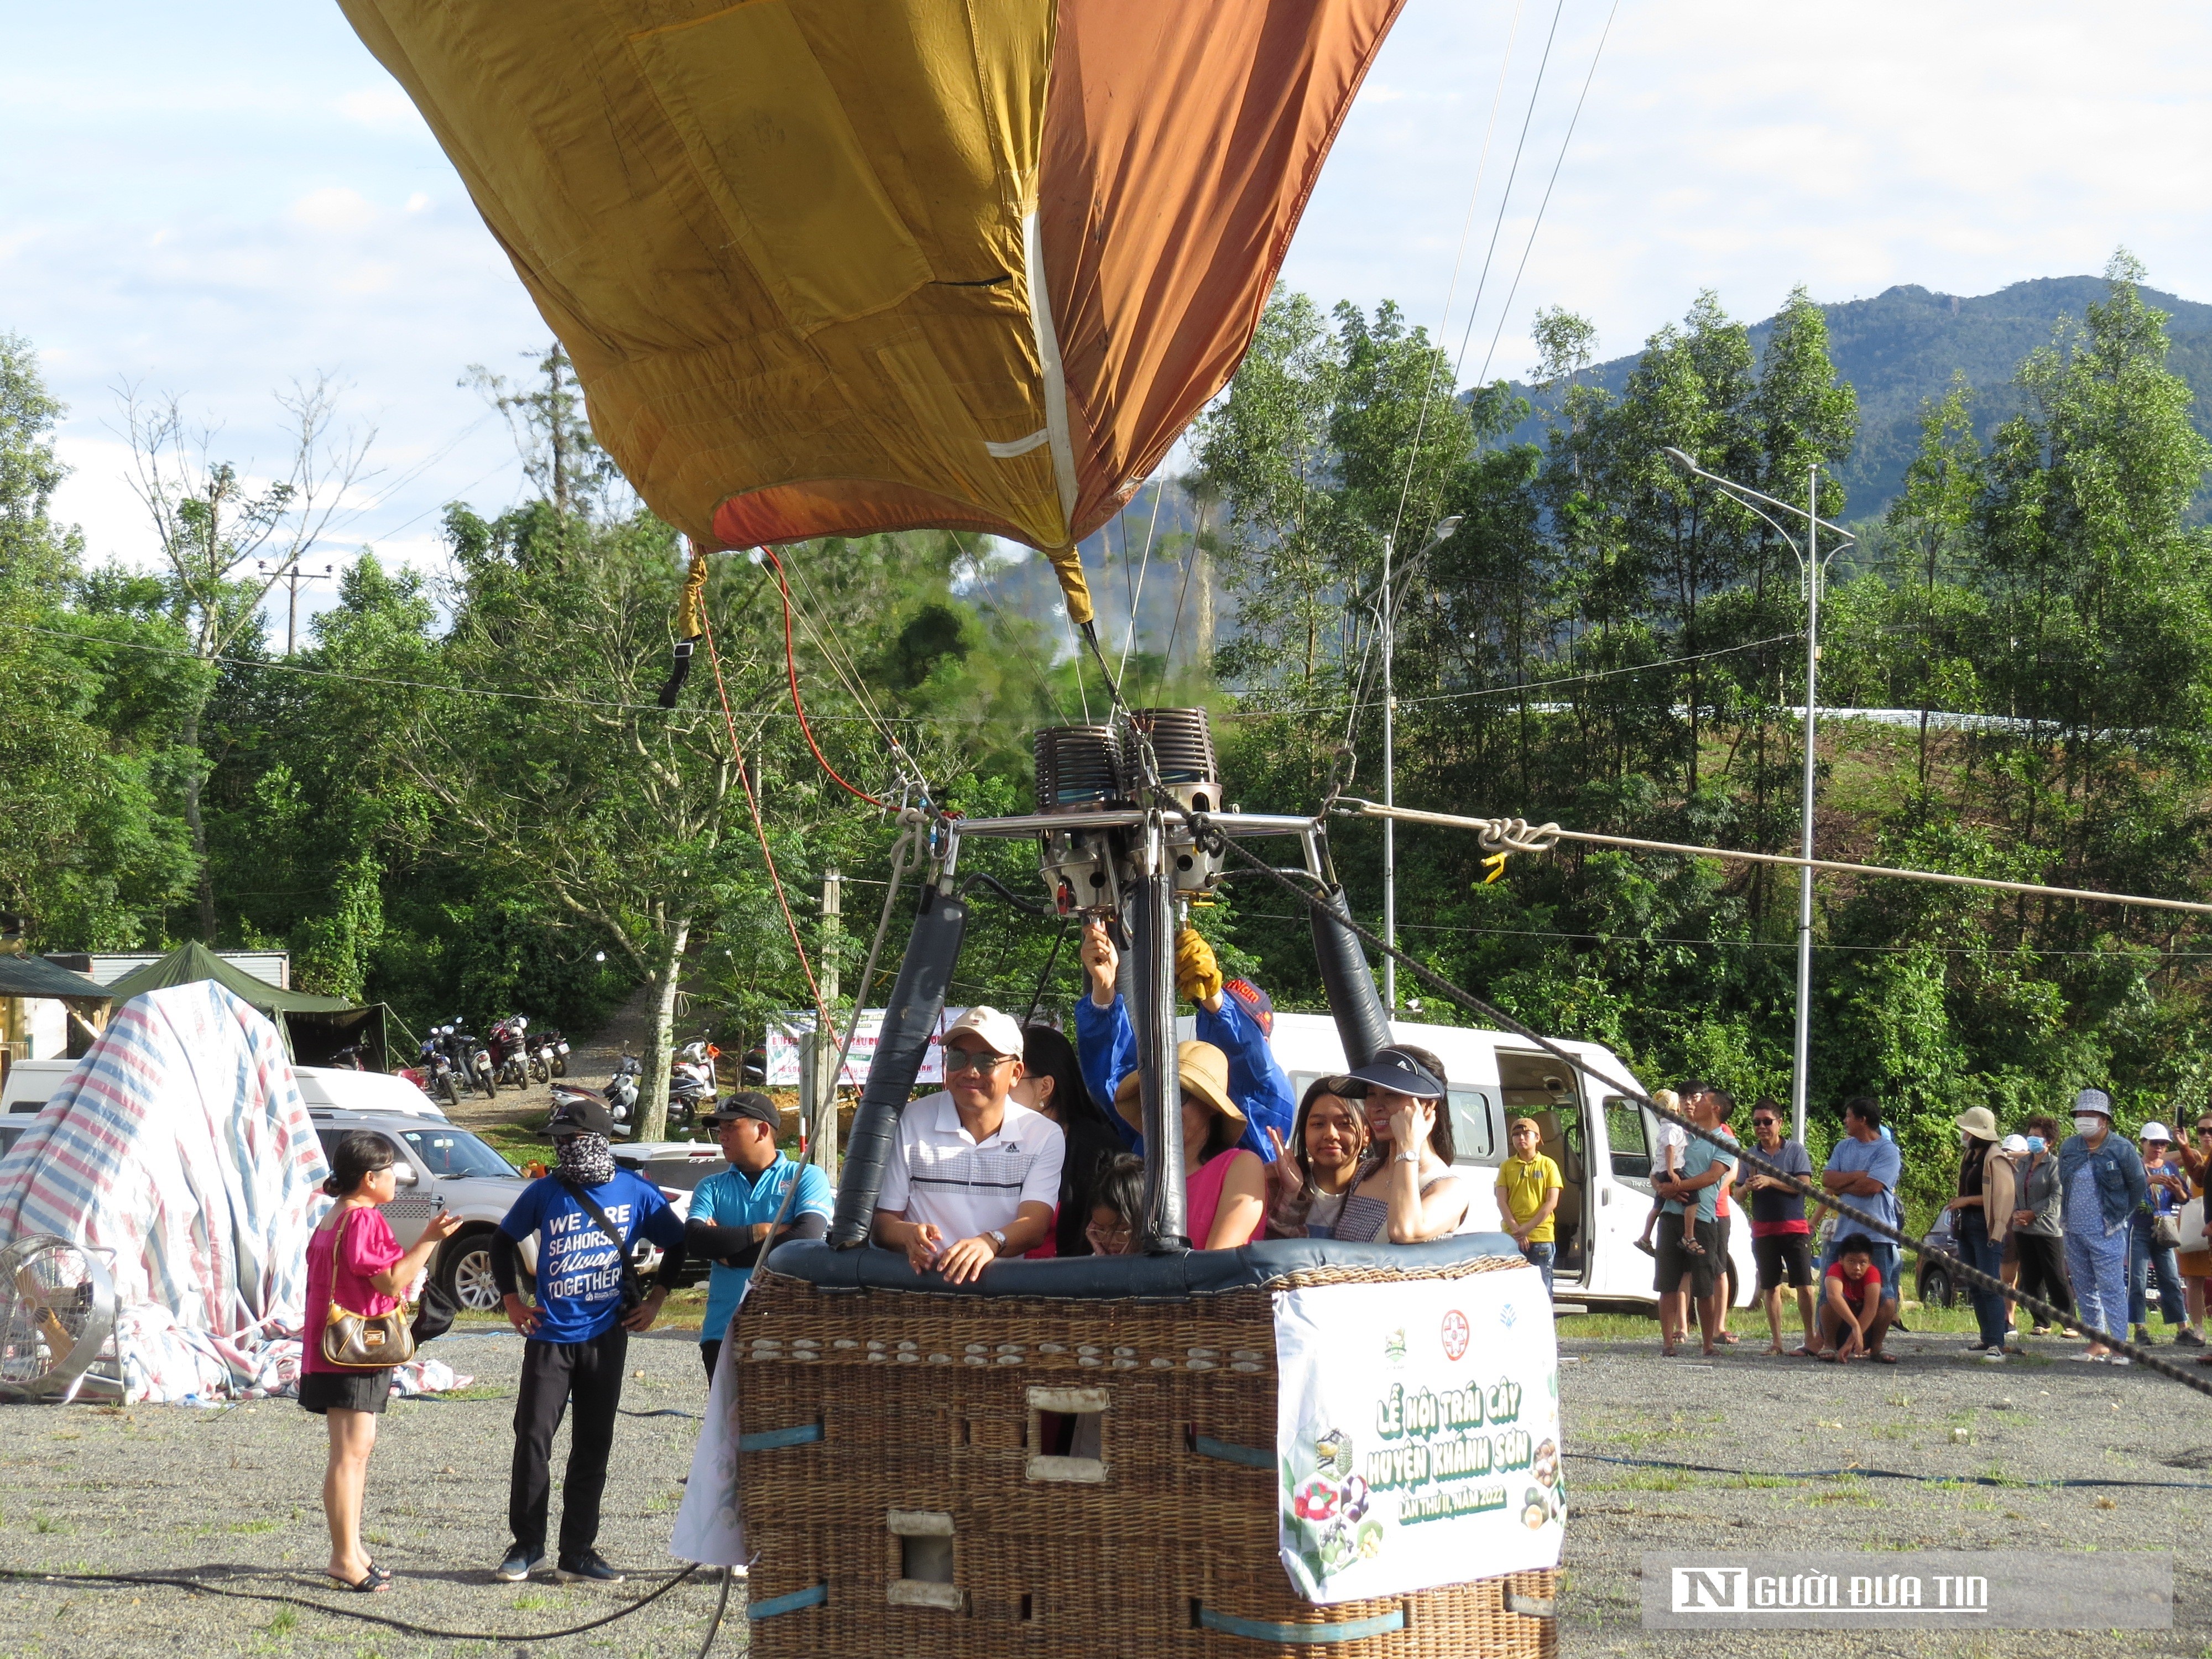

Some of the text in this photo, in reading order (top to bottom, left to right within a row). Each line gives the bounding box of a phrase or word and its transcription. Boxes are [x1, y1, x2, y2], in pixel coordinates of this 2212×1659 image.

[549, 1213, 582, 1235] WE
[549, 1225, 628, 1256] SEAHORS!
[550, 1249, 621, 1276] Always
[1377, 1376, 1521, 1440] LỄ HỘI TRÁI CÂY
[1367, 1428, 1531, 1493] HUYỆN KHÁNH SƠN
[1399, 1491, 1419, 1524] LẦN
[1420, 1490, 1441, 1520] THỨ
[1454, 1486, 1479, 1514] NĂM
[1480, 1485, 1506, 1510] 2022
